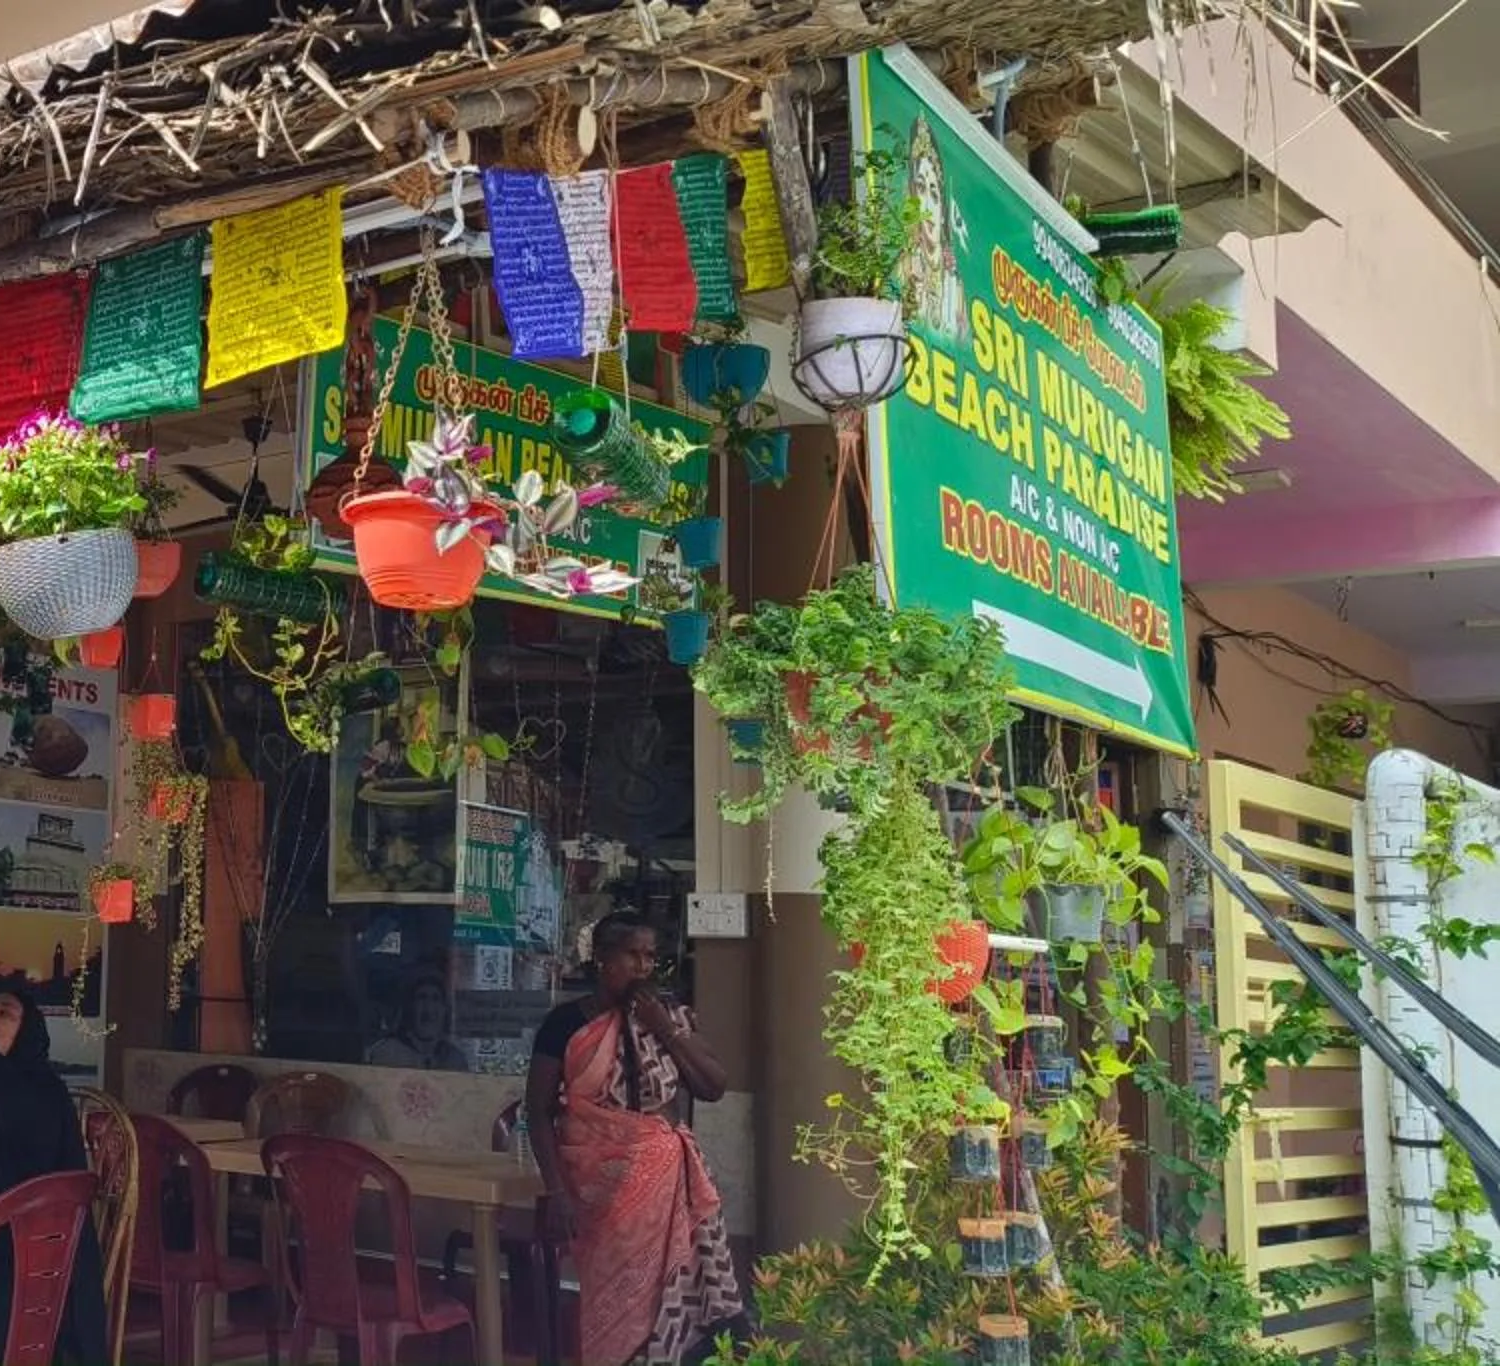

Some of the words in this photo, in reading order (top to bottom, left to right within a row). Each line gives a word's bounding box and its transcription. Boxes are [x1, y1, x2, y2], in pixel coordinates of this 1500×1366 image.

[904, 335, 1036, 471] BEACH
[1042, 425, 1170, 563] PARADISE
[971, 300, 1029, 399] SRI
[1036, 350, 1167, 504] MURUGAN
[940, 484, 1053, 594] ROOMS
[1046, 496, 1059, 532] &
[1062, 505, 1097, 557] NON
